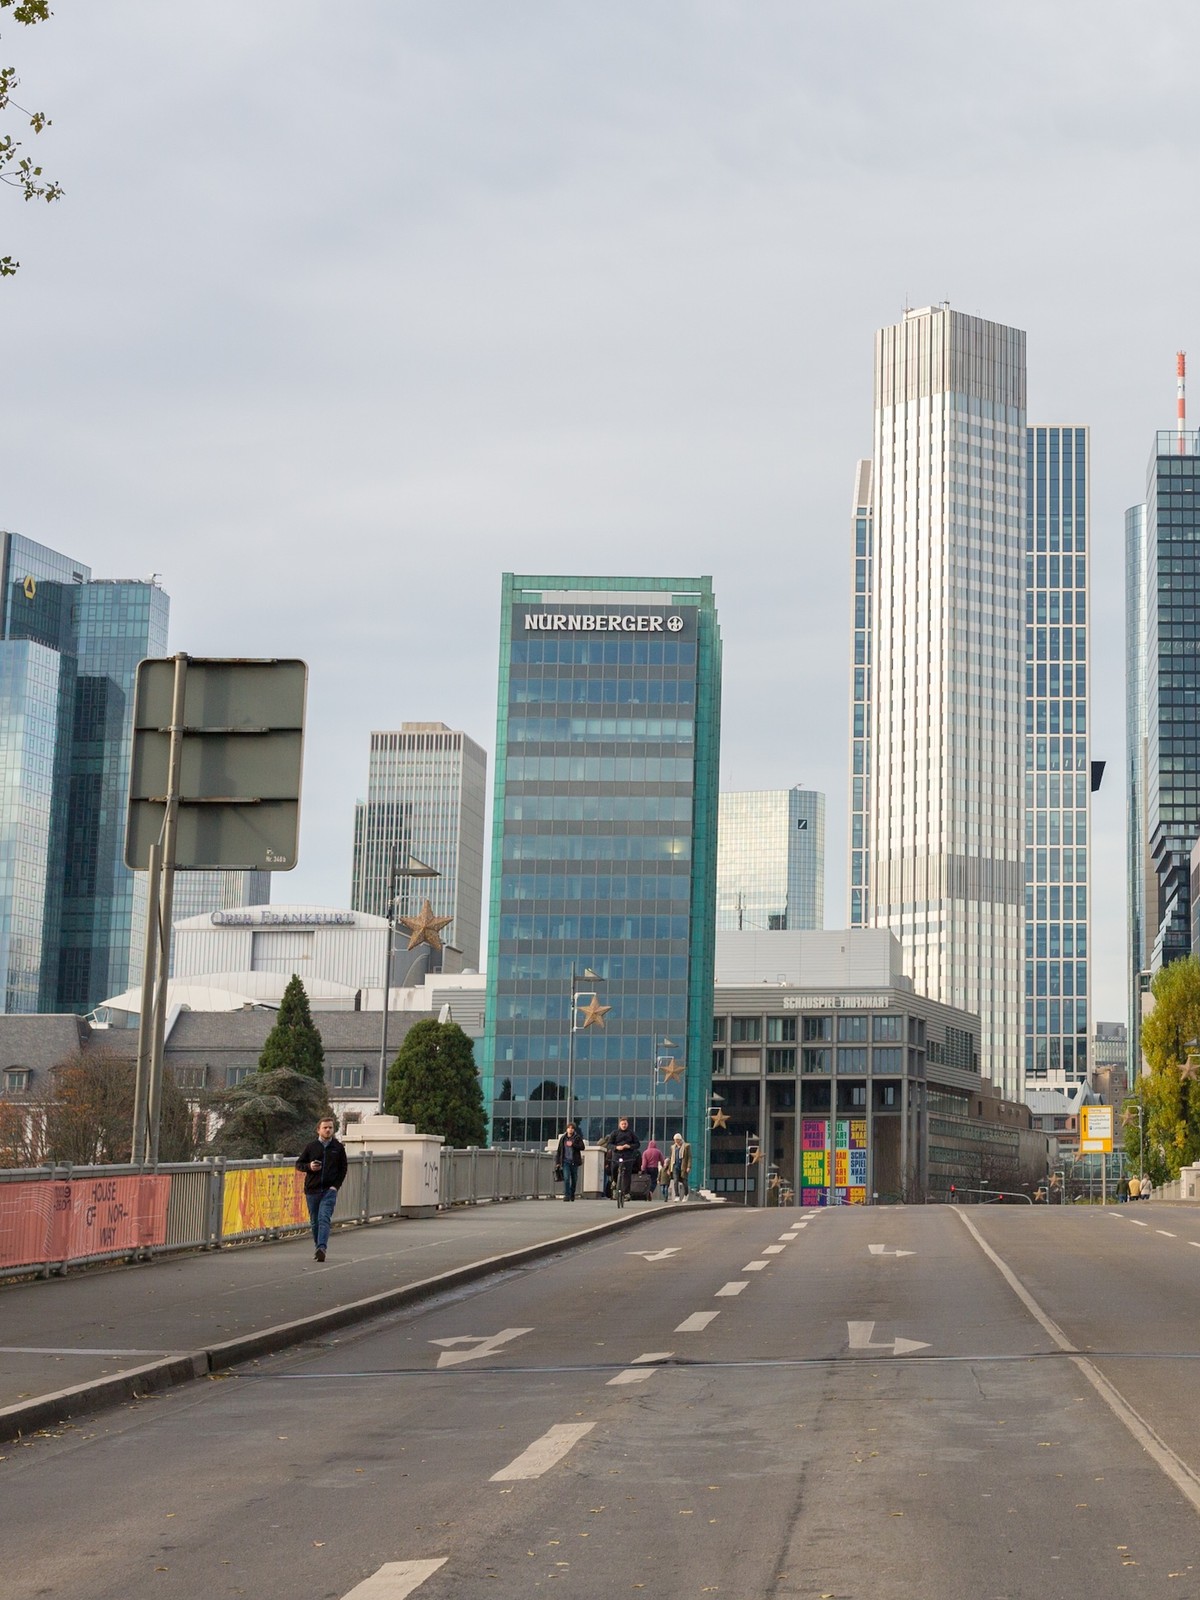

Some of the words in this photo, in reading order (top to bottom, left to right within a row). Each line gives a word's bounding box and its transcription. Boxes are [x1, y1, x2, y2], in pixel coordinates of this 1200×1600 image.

[525, 613, 663, 632] NÜRNBERGER
[261, 910, 355, 925] FRANKFURT
[783, 996, 836, 1009] SCHAUSPIEL
[851, 1151, 866, 1160] SCHA
[92, 1181, 116, 1203] HOUSE
[86, 1205, 97, 1226] OF
[108, 1203, 128, 1224] NOR-
[99, 1227, 116, 1247] WAY
